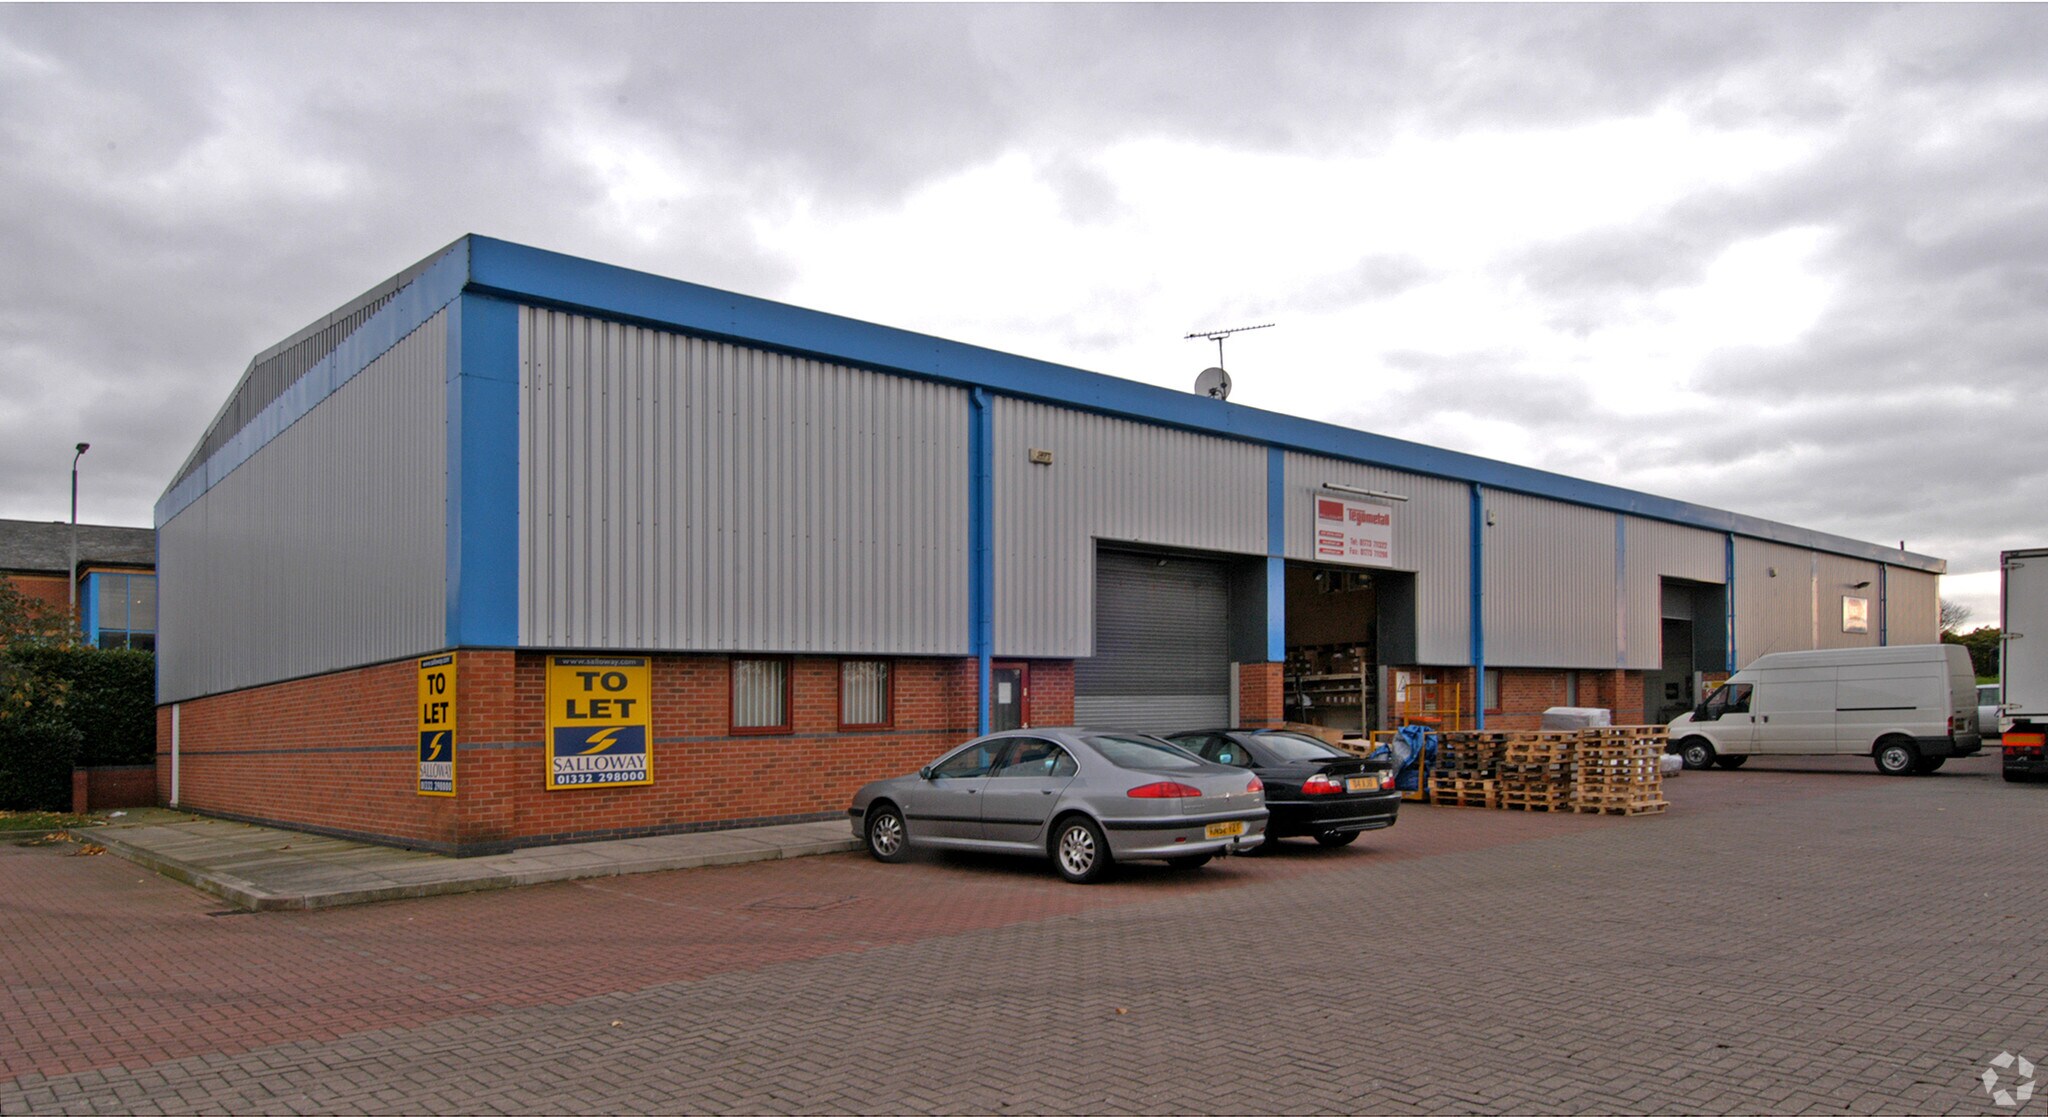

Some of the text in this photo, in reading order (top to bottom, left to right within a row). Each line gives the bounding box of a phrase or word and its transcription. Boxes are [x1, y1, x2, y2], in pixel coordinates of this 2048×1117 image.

[562, 658, 637, 666] www.salloway.com
[427, 672, 446, 695] TO
[576, 671, 628, 692] TO
[423, 702, 449, 724] LET
[566, 699, 636, 719] LET
[420, 762, 452, 779] SALLOWAY
[553, 754, 647, 773] SALLOWAY
[557, 771, 645, 784] 01332 298000
